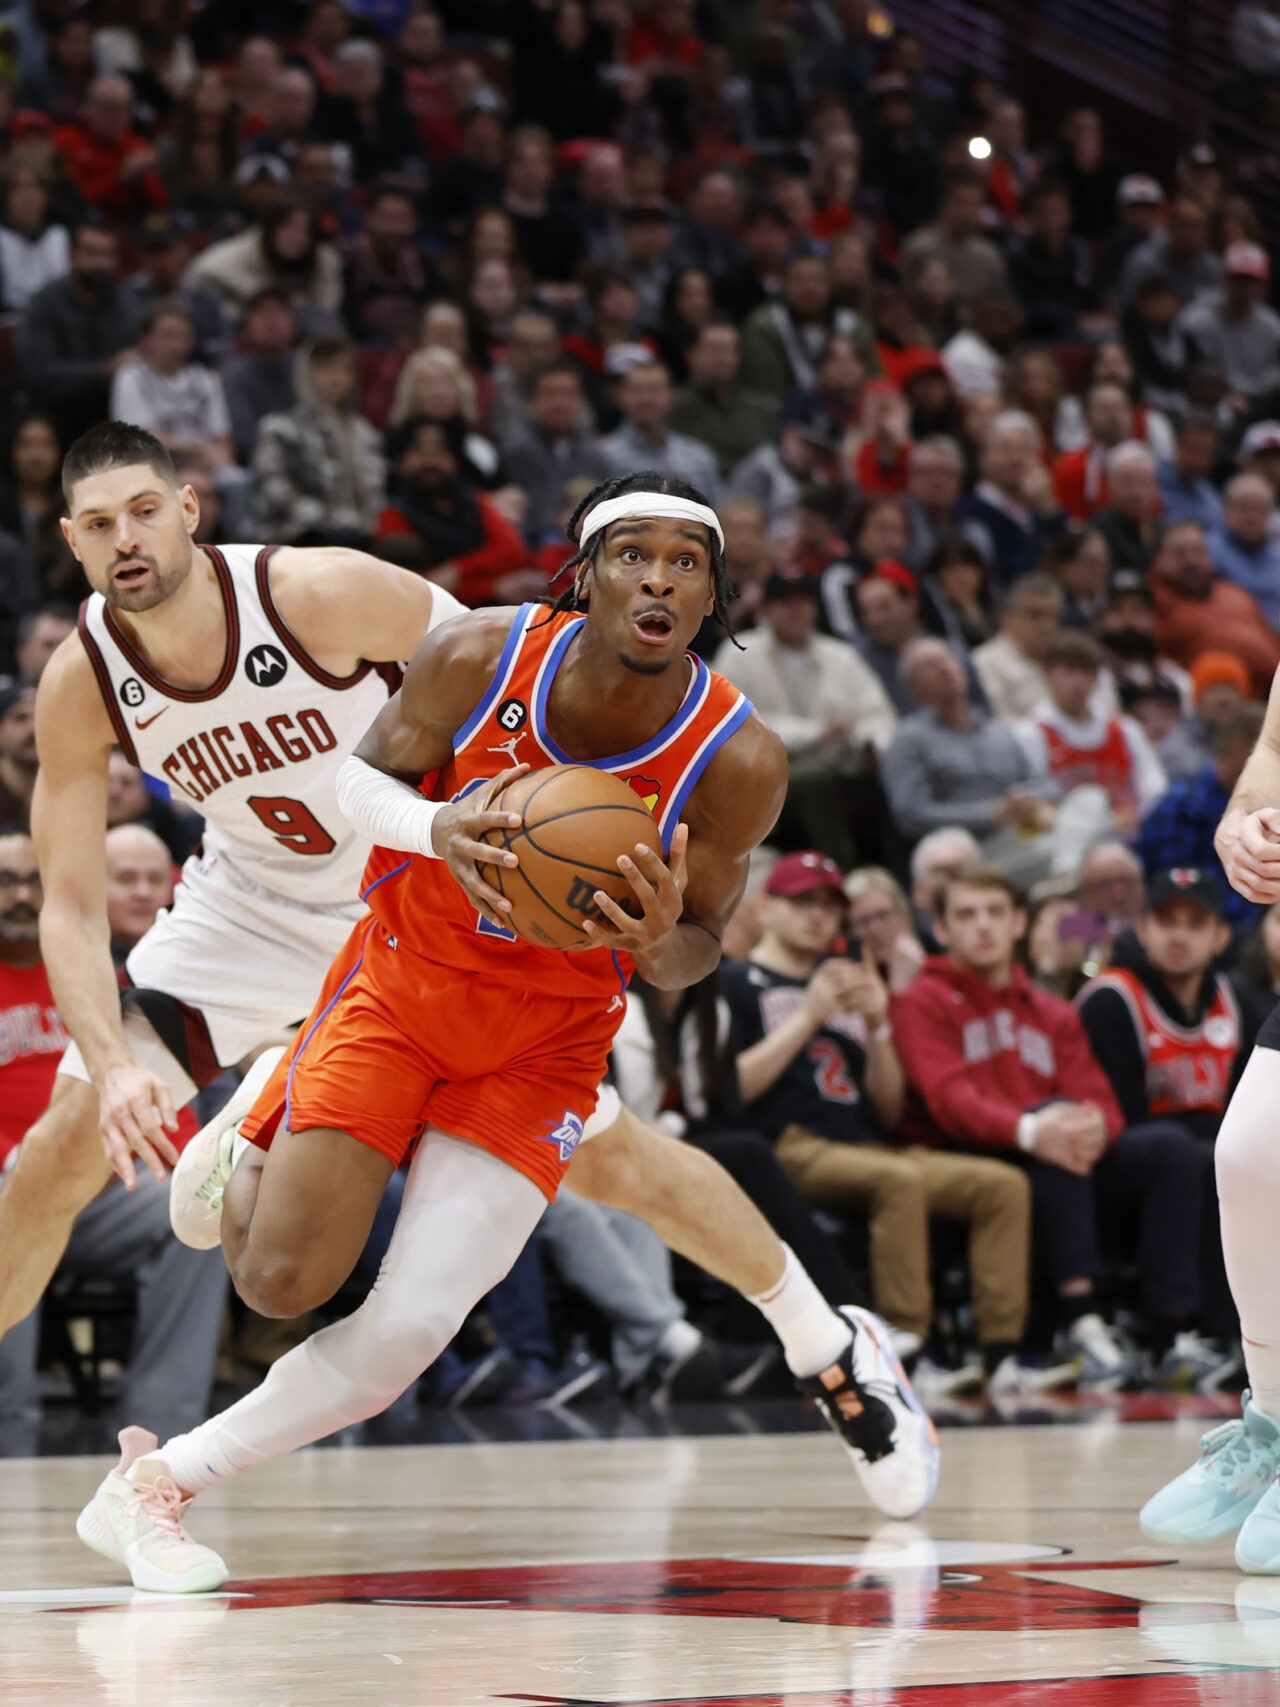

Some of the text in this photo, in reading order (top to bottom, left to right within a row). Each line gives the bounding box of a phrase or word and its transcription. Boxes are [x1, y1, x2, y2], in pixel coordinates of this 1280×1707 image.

[501, 703, 524, 730] 6
[162, 708, 338, 803] CHICAGO
[246, 795, 337, 856] 9
[808, 1036, 860, 1106] 2
